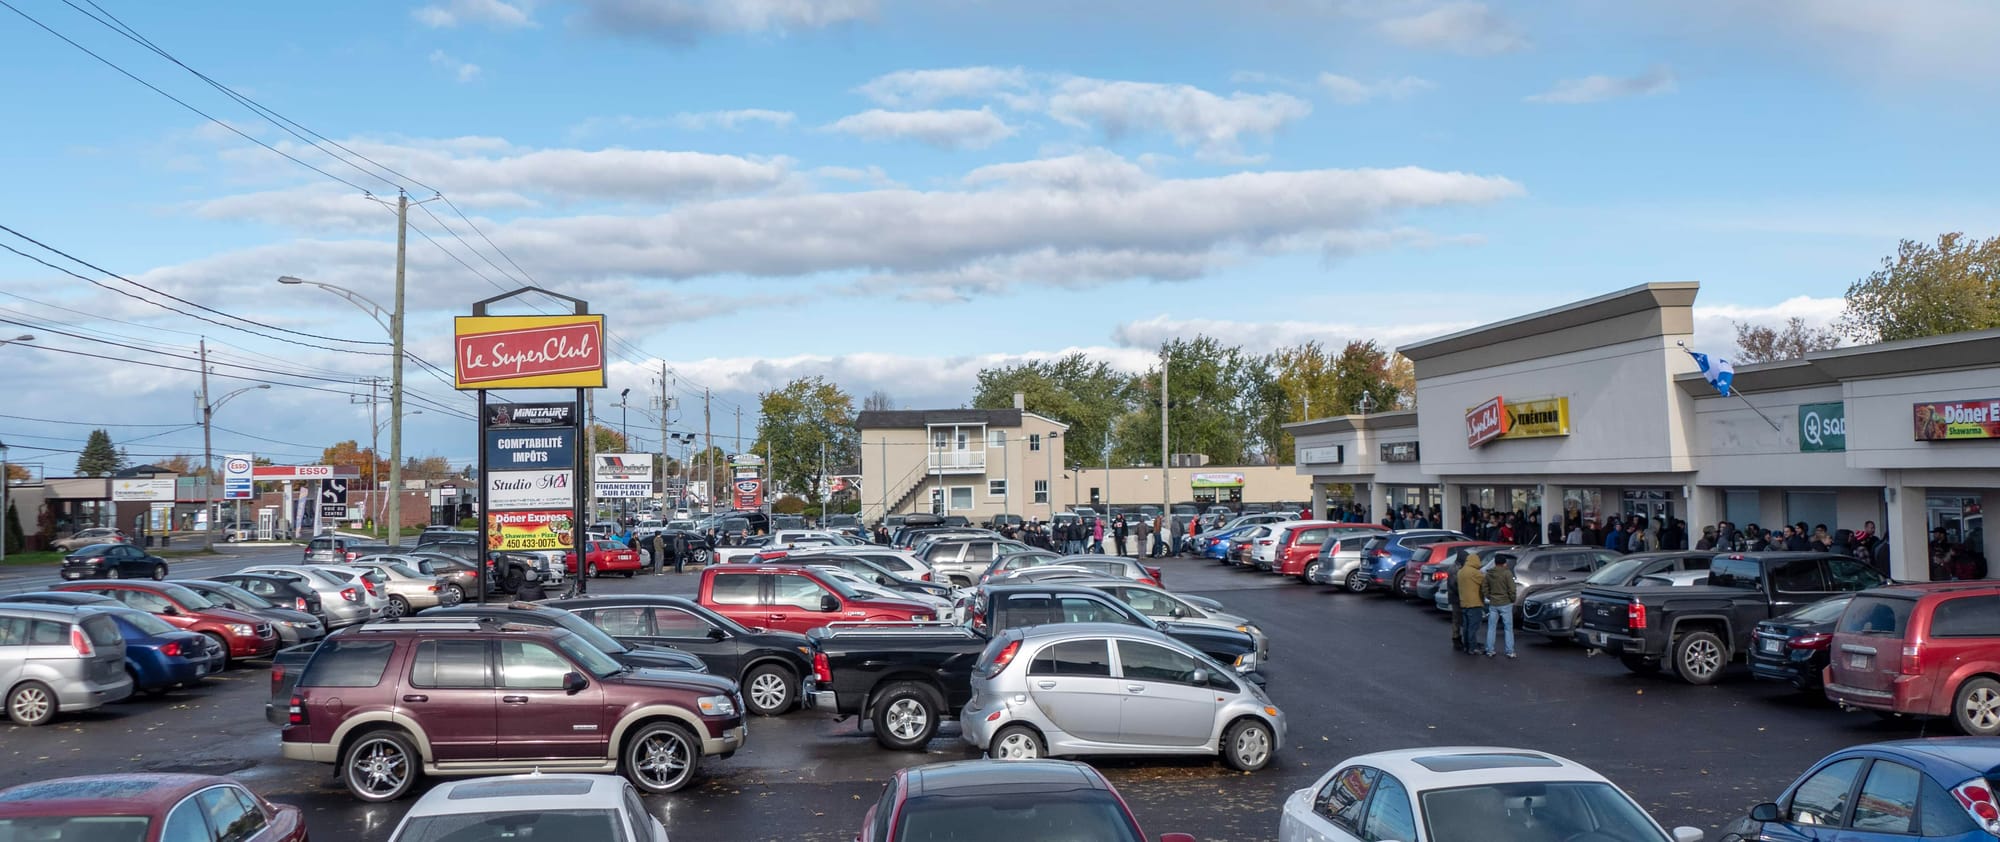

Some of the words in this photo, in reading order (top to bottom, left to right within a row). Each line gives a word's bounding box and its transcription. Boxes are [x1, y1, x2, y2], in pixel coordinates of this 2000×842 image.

[466, 344, 489, 369] Le
[491, 333, 593, 373] SuperClub
[512, 407, 569, 420] MINOTAURE
[1944, 404, 1988, 425] Döner
[1949, 427, 1982, 435] Shawarma
[497, 435, 563, 449] COMPTABILITÉ
[512, 450, 548, 463] IMPÔTS
[299, 467, 328, 475] ESSO
[491, 478, 532, 491] Studio
[495, 513, 527, 523] Döner
[527, 513, 567, 523] Express
[506, 539, 521, 549] 450
[522, 538, 556, 548] 433-0075
